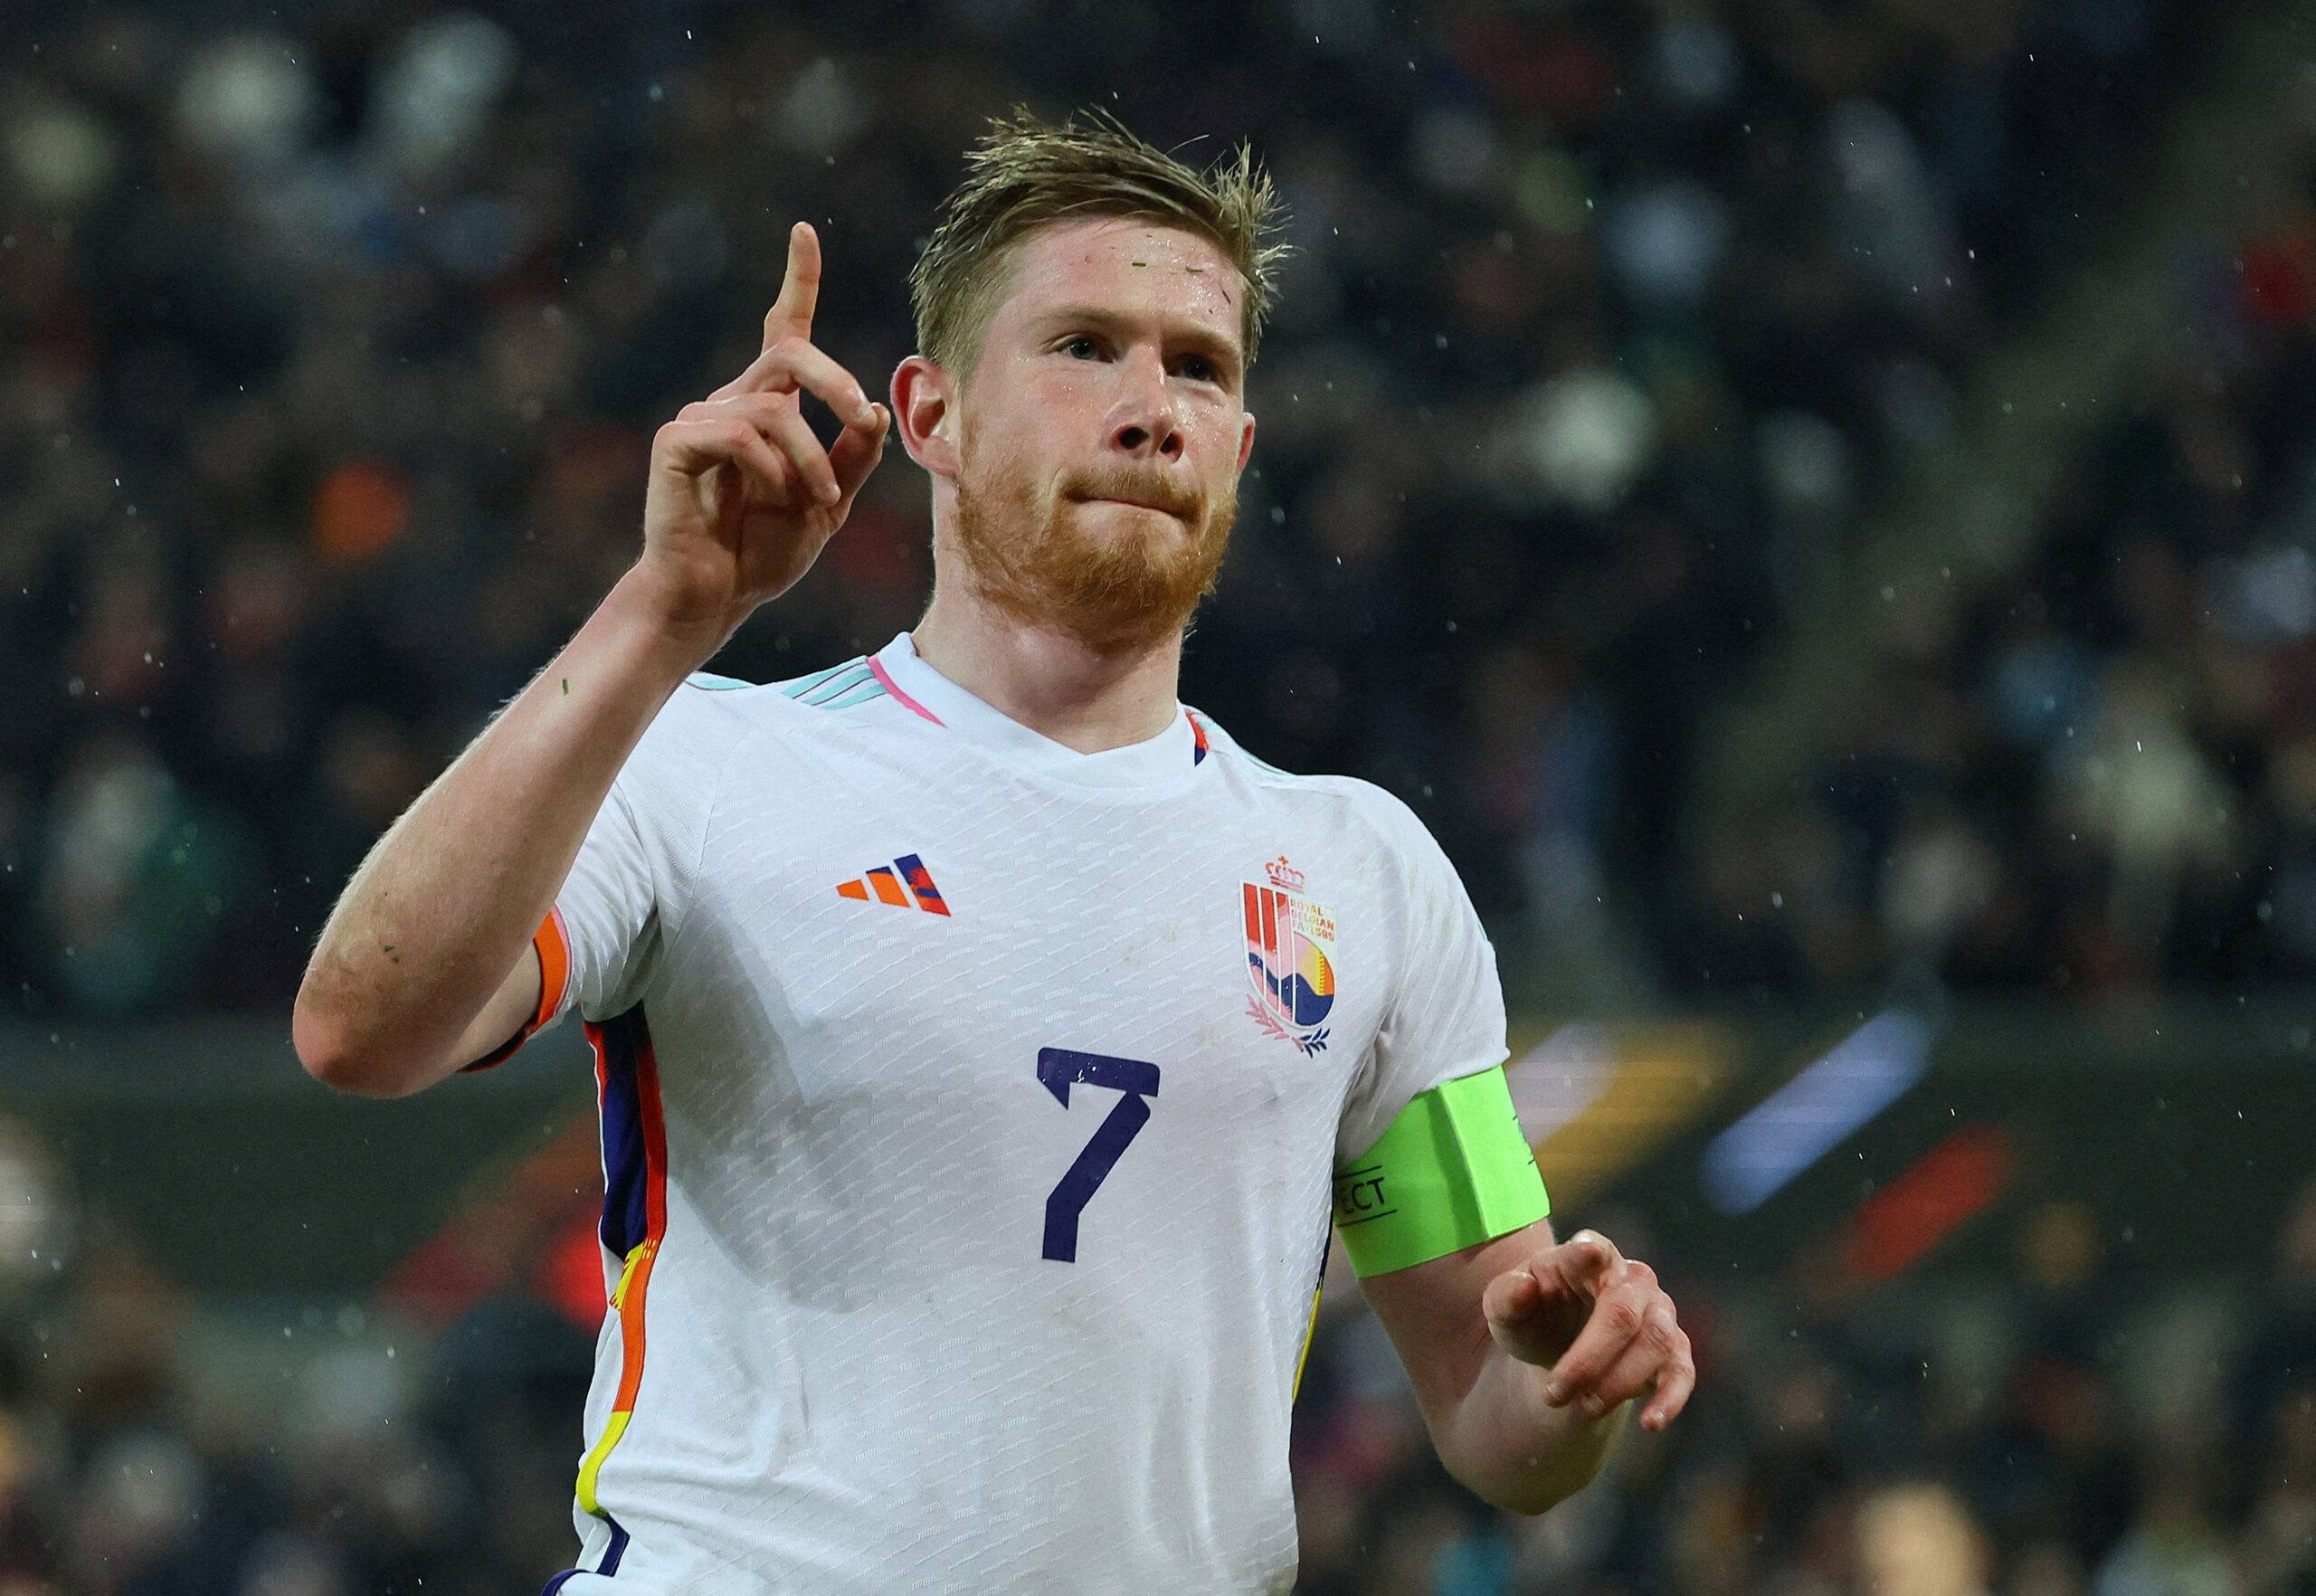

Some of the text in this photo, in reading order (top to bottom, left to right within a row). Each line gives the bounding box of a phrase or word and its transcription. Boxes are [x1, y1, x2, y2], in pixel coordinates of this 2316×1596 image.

[1290, 899, 1324, 917] ROYAL
[1291, 908, 1334, 931] BELGIAN
[1037, 1047, 1161, 1263] 7
[1336, 1175, 1385, 1214] ECT
